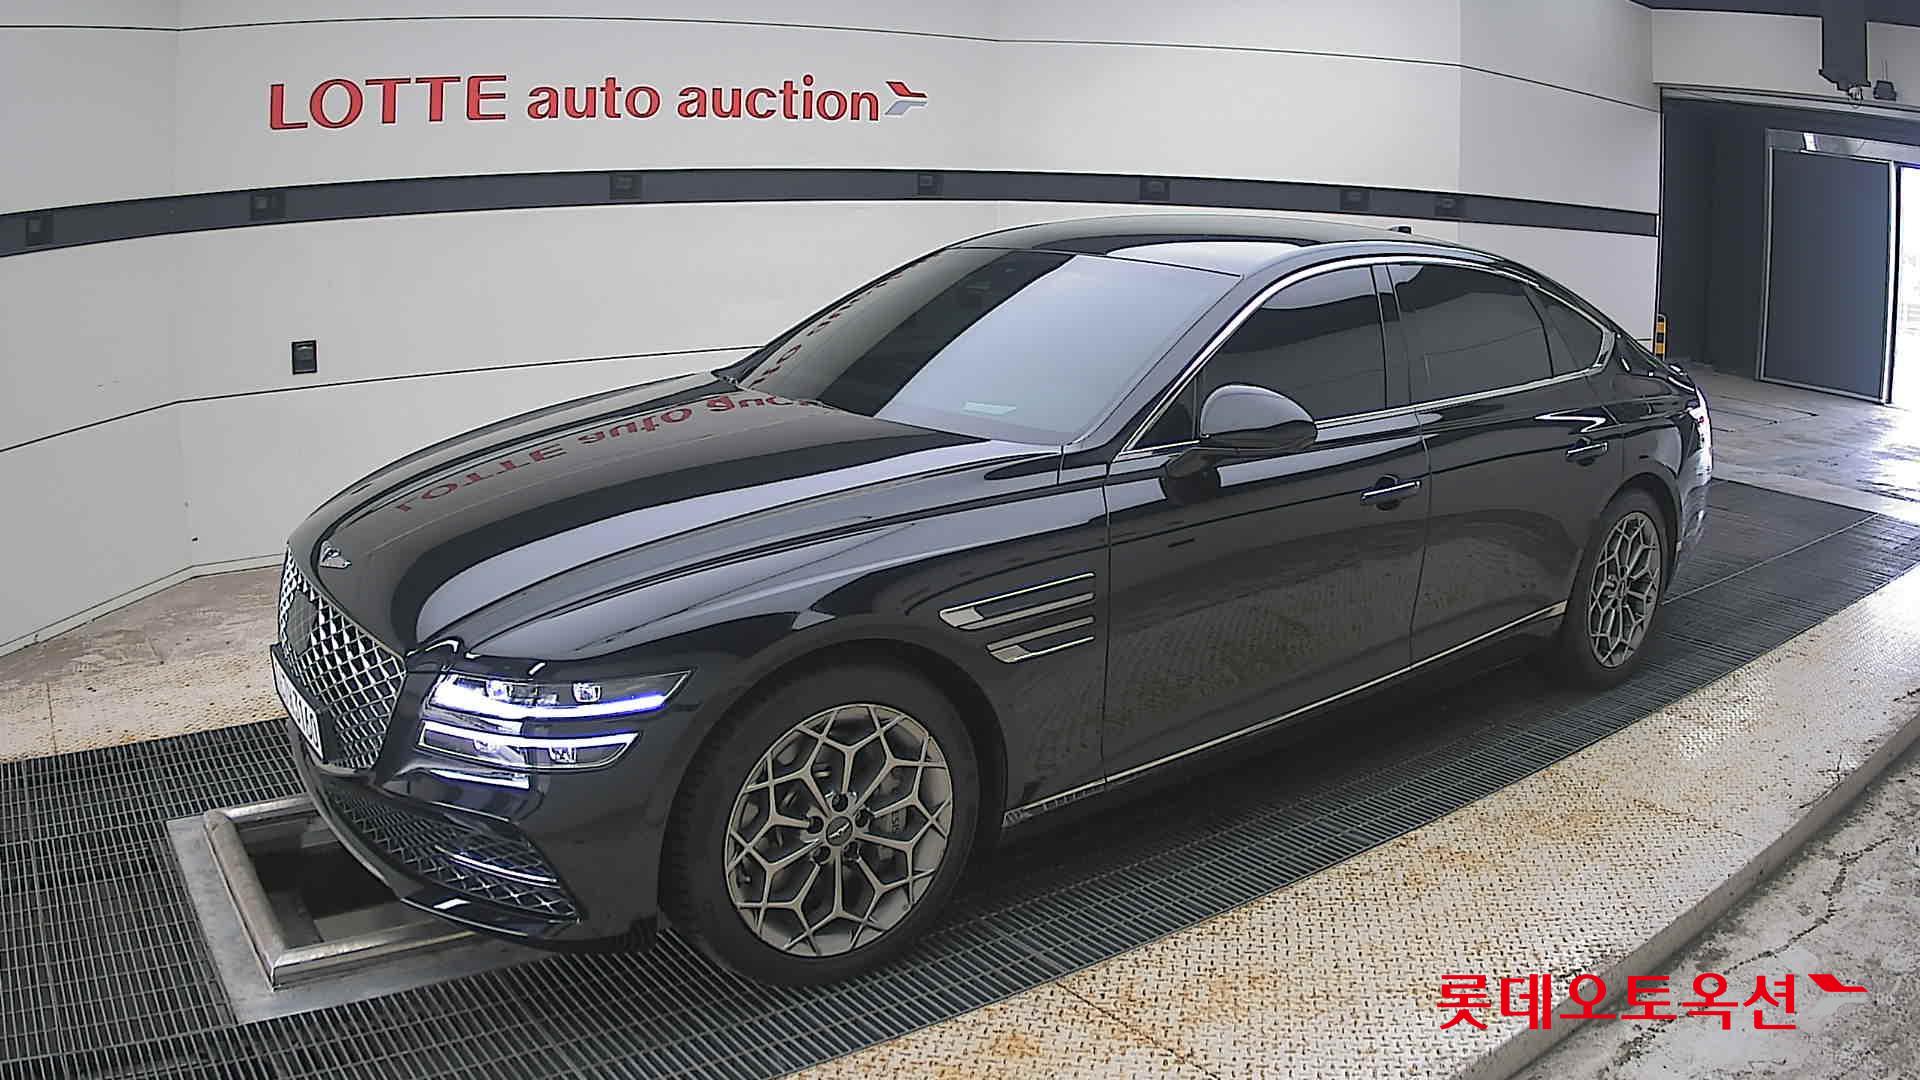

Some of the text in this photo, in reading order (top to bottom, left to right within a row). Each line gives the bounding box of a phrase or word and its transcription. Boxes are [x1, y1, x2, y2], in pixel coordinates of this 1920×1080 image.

[269, 74, 880, 129] LOTTE auto auction
